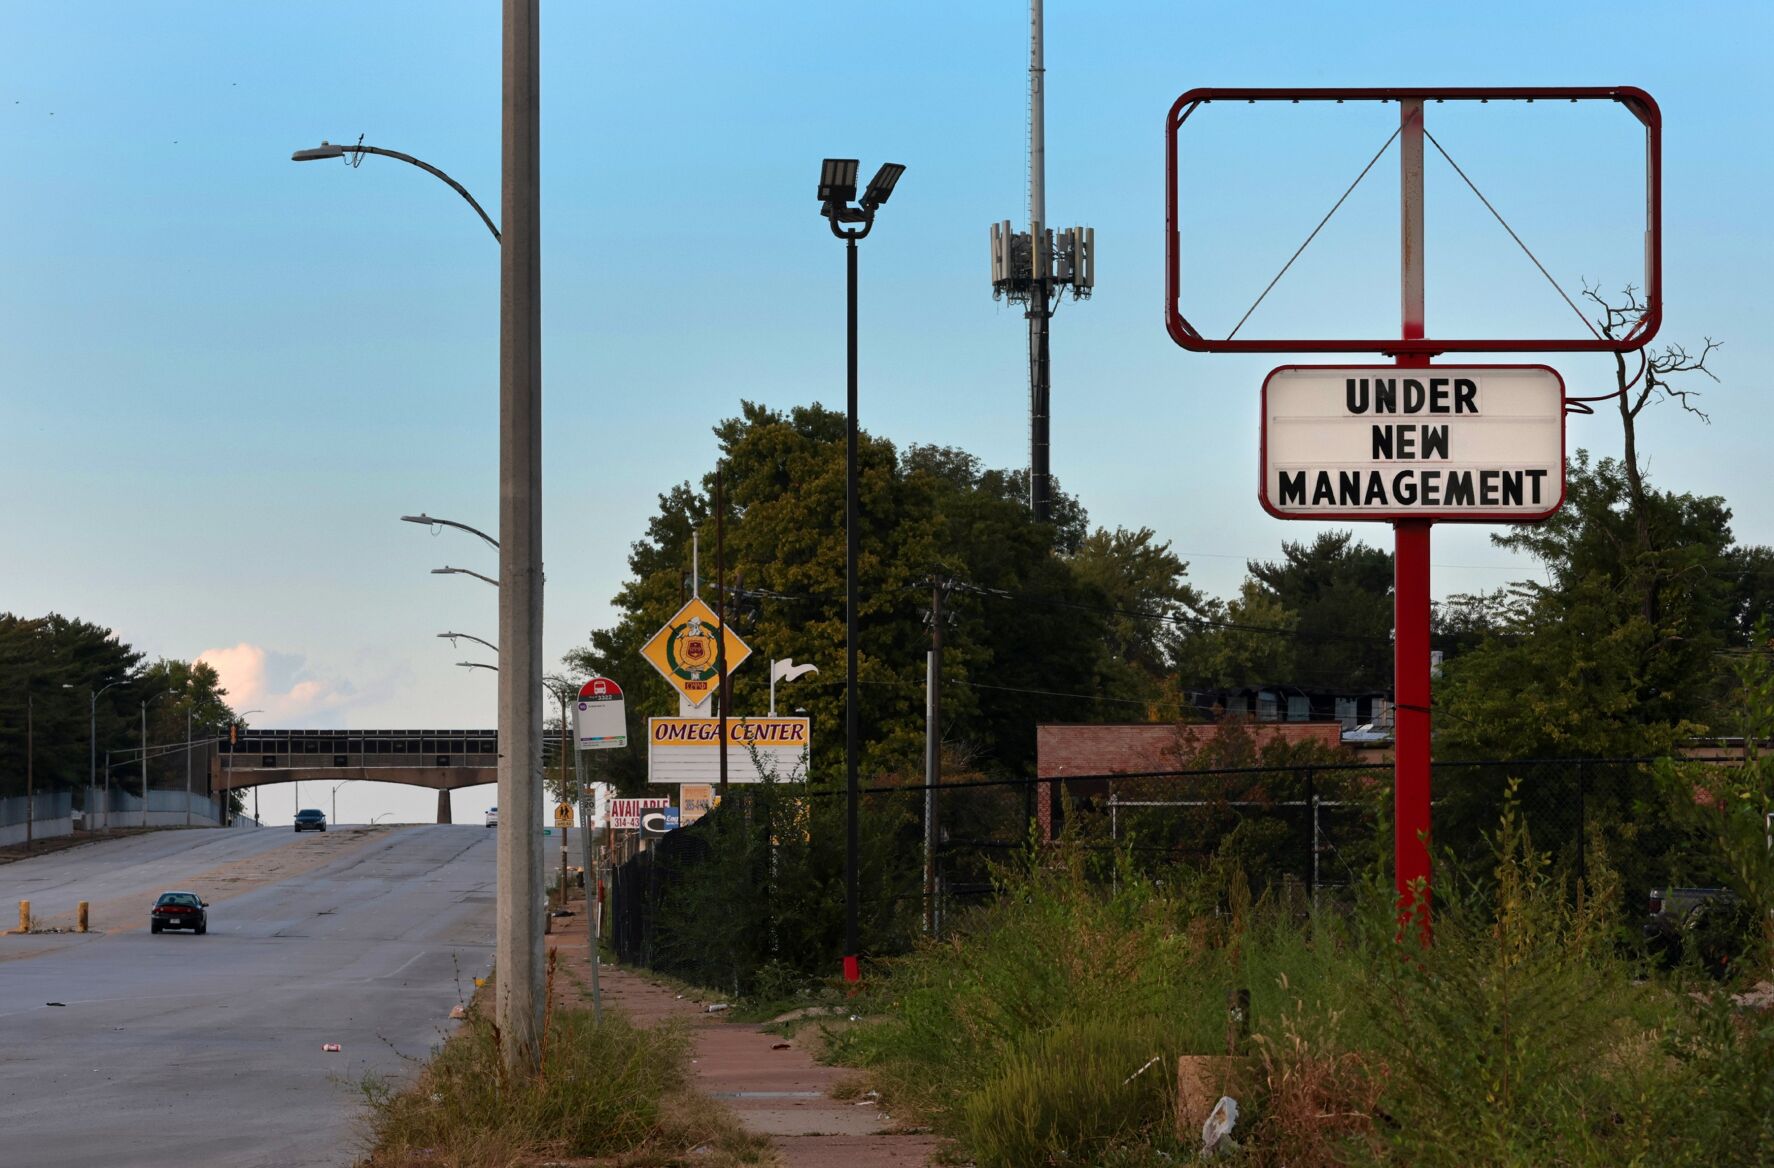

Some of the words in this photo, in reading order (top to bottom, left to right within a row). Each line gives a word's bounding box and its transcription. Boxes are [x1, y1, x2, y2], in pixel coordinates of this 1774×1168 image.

[1346, 378, 1479, 414] UNDER
[1372, 424, 1449, 460] NEW
[1278, 469, 1548, 506] MANAGEMENT
[655, 723, 721, 741] OMEGA
[730, 723, 805, 741] CENTER
[584, 801, 595, 809] 20
